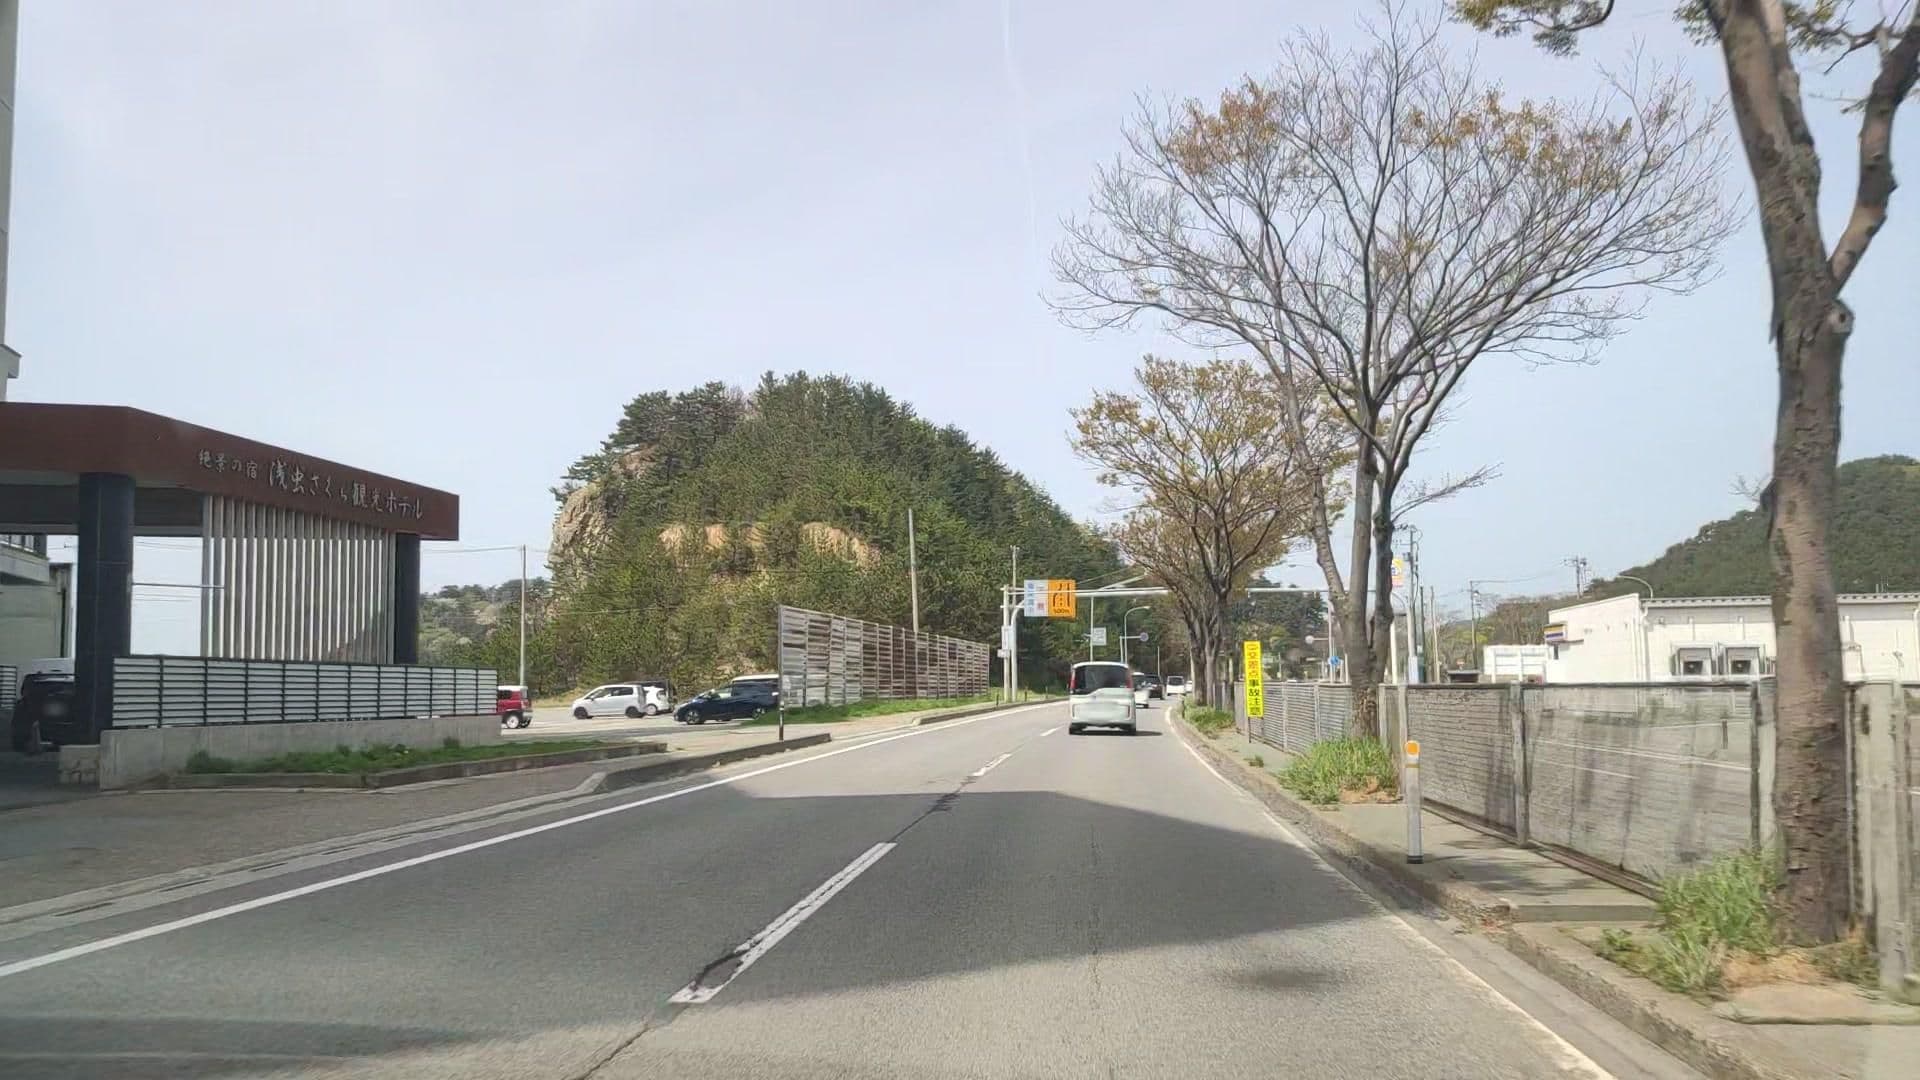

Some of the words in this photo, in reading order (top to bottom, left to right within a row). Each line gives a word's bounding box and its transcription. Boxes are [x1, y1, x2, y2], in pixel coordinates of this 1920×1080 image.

[199, 449, 258, 479] 絶景の宿
[269, 457, 423, 520] 浅虫さくら観光ホテル
